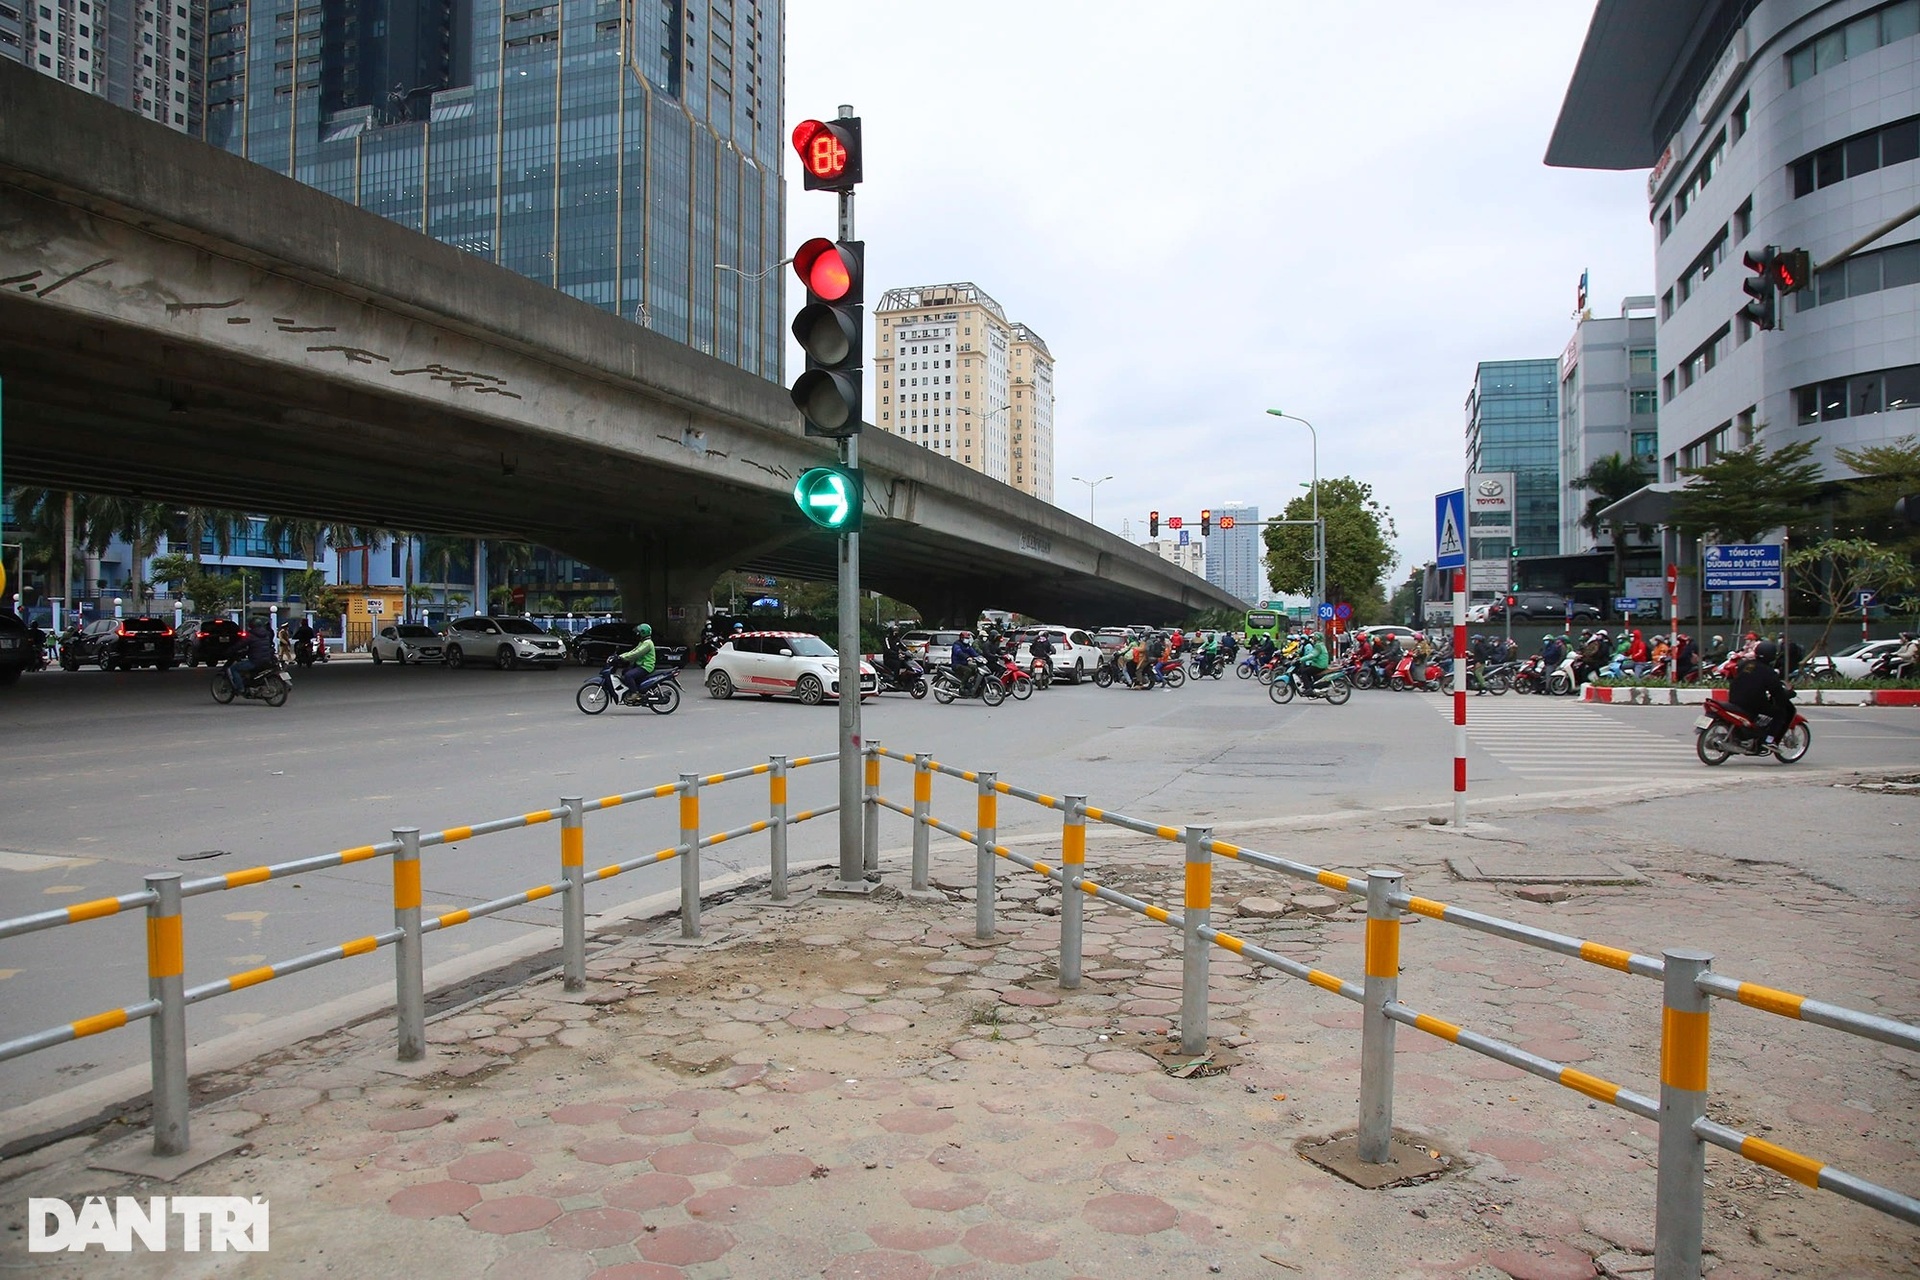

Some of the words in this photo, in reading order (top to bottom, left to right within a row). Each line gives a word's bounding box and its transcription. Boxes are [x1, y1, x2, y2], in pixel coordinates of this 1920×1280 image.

[1707, 578, 1728, 586] 400m
[1860, 593, 1871, 605] P
[1320, 606, 1333, 617] 30
